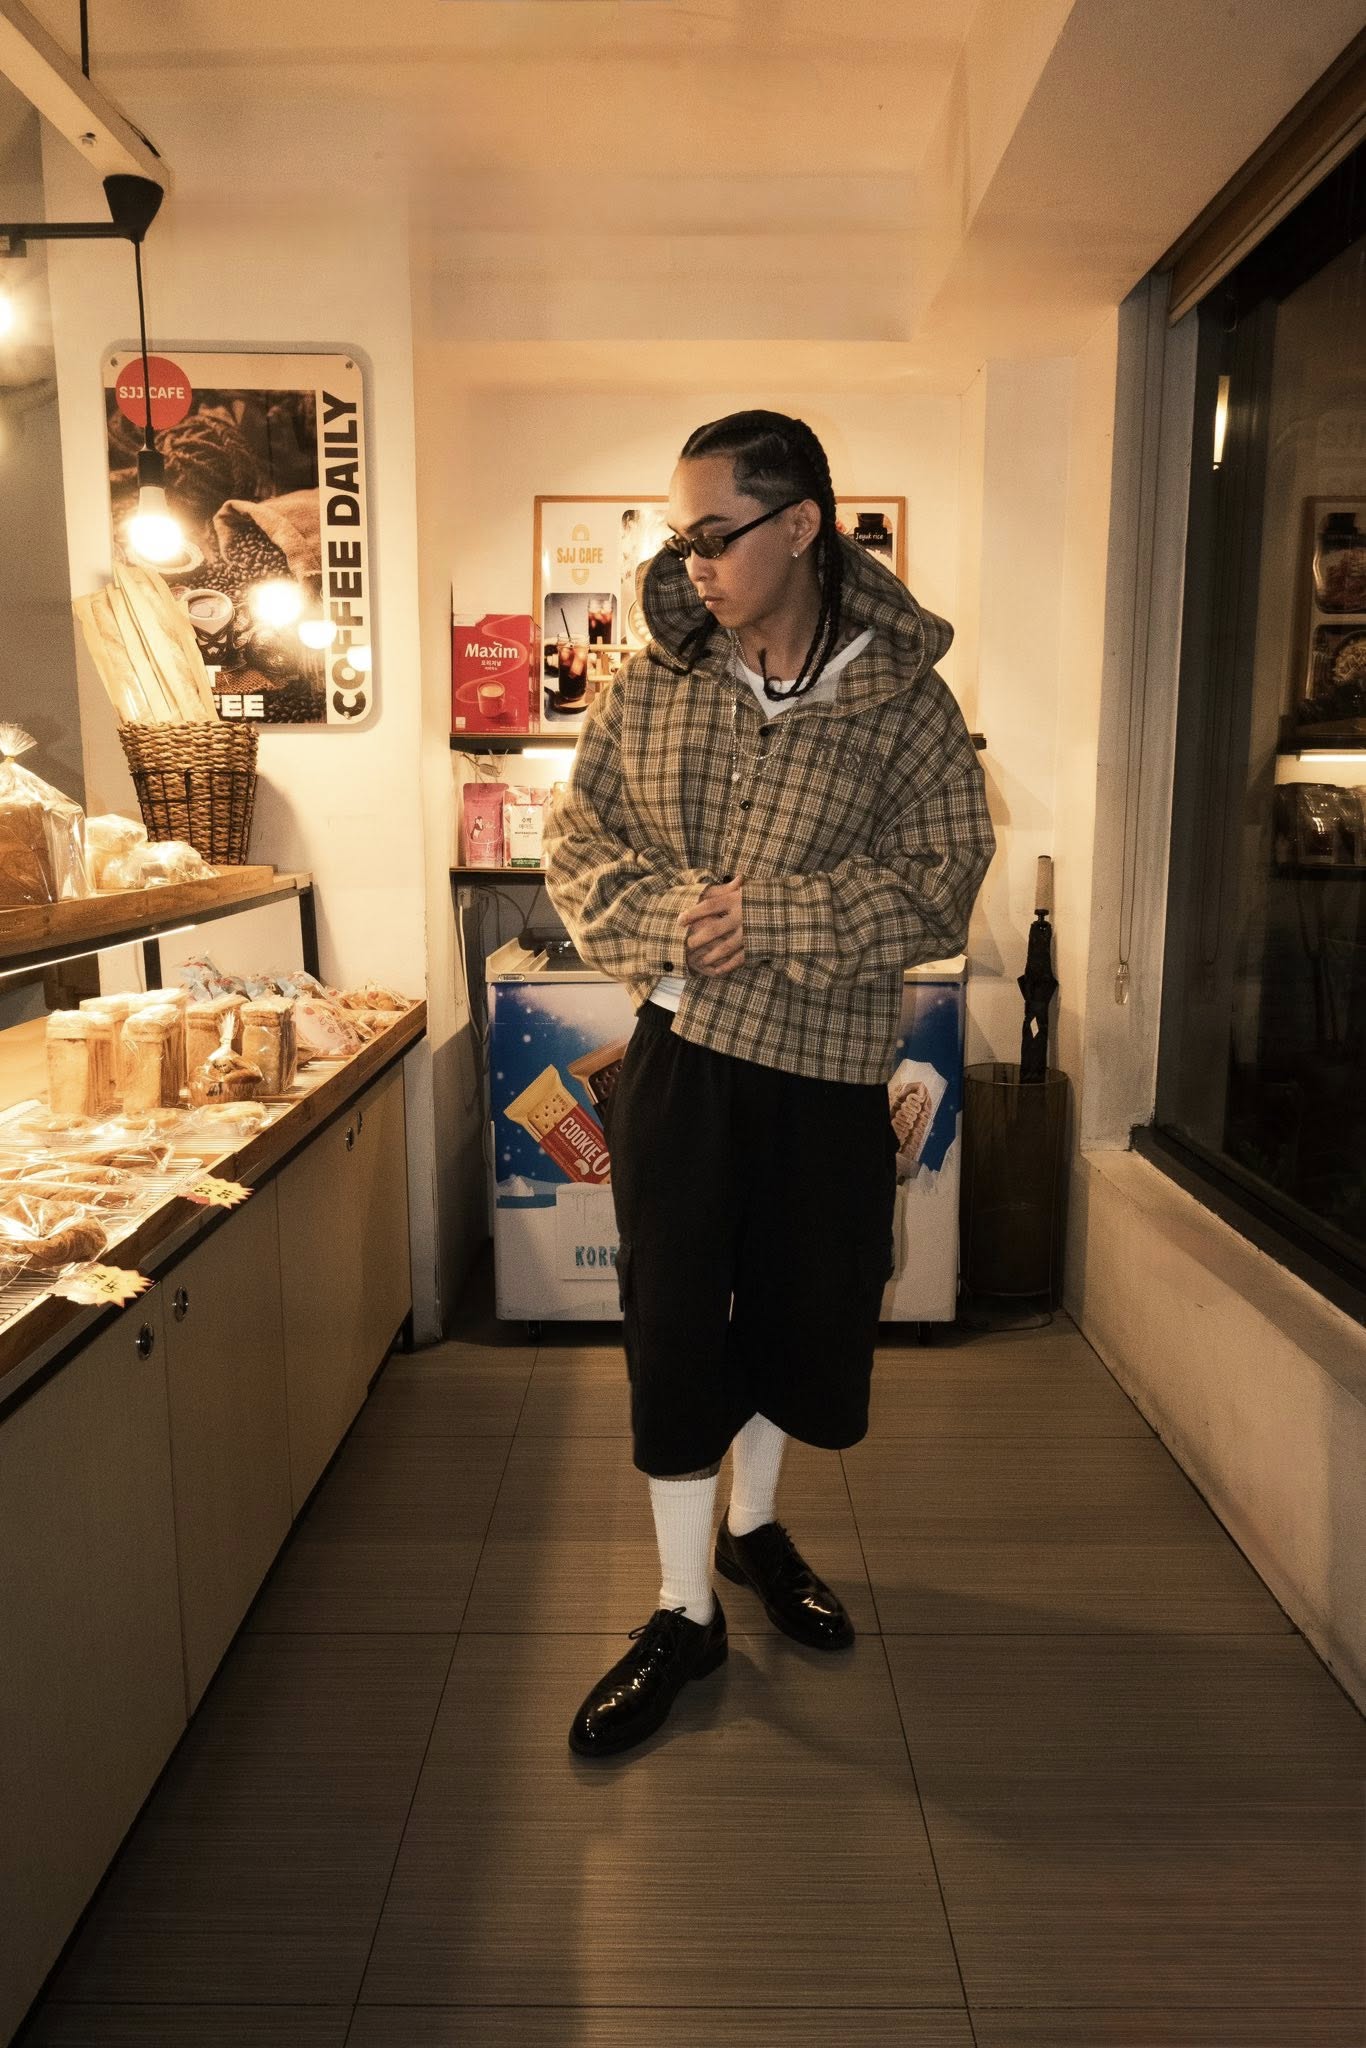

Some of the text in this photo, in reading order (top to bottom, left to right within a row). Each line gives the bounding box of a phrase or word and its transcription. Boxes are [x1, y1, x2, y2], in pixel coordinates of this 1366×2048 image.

[119, 386, 185, 399] SJJ CAFE
[322, 390, 367, 720] COFFEE DAILY
[556, 546, 604, 564] SJJ CAFE
[465, 641, 518, 659] Maxim
[575, 1245, 618, 1267] KORE
